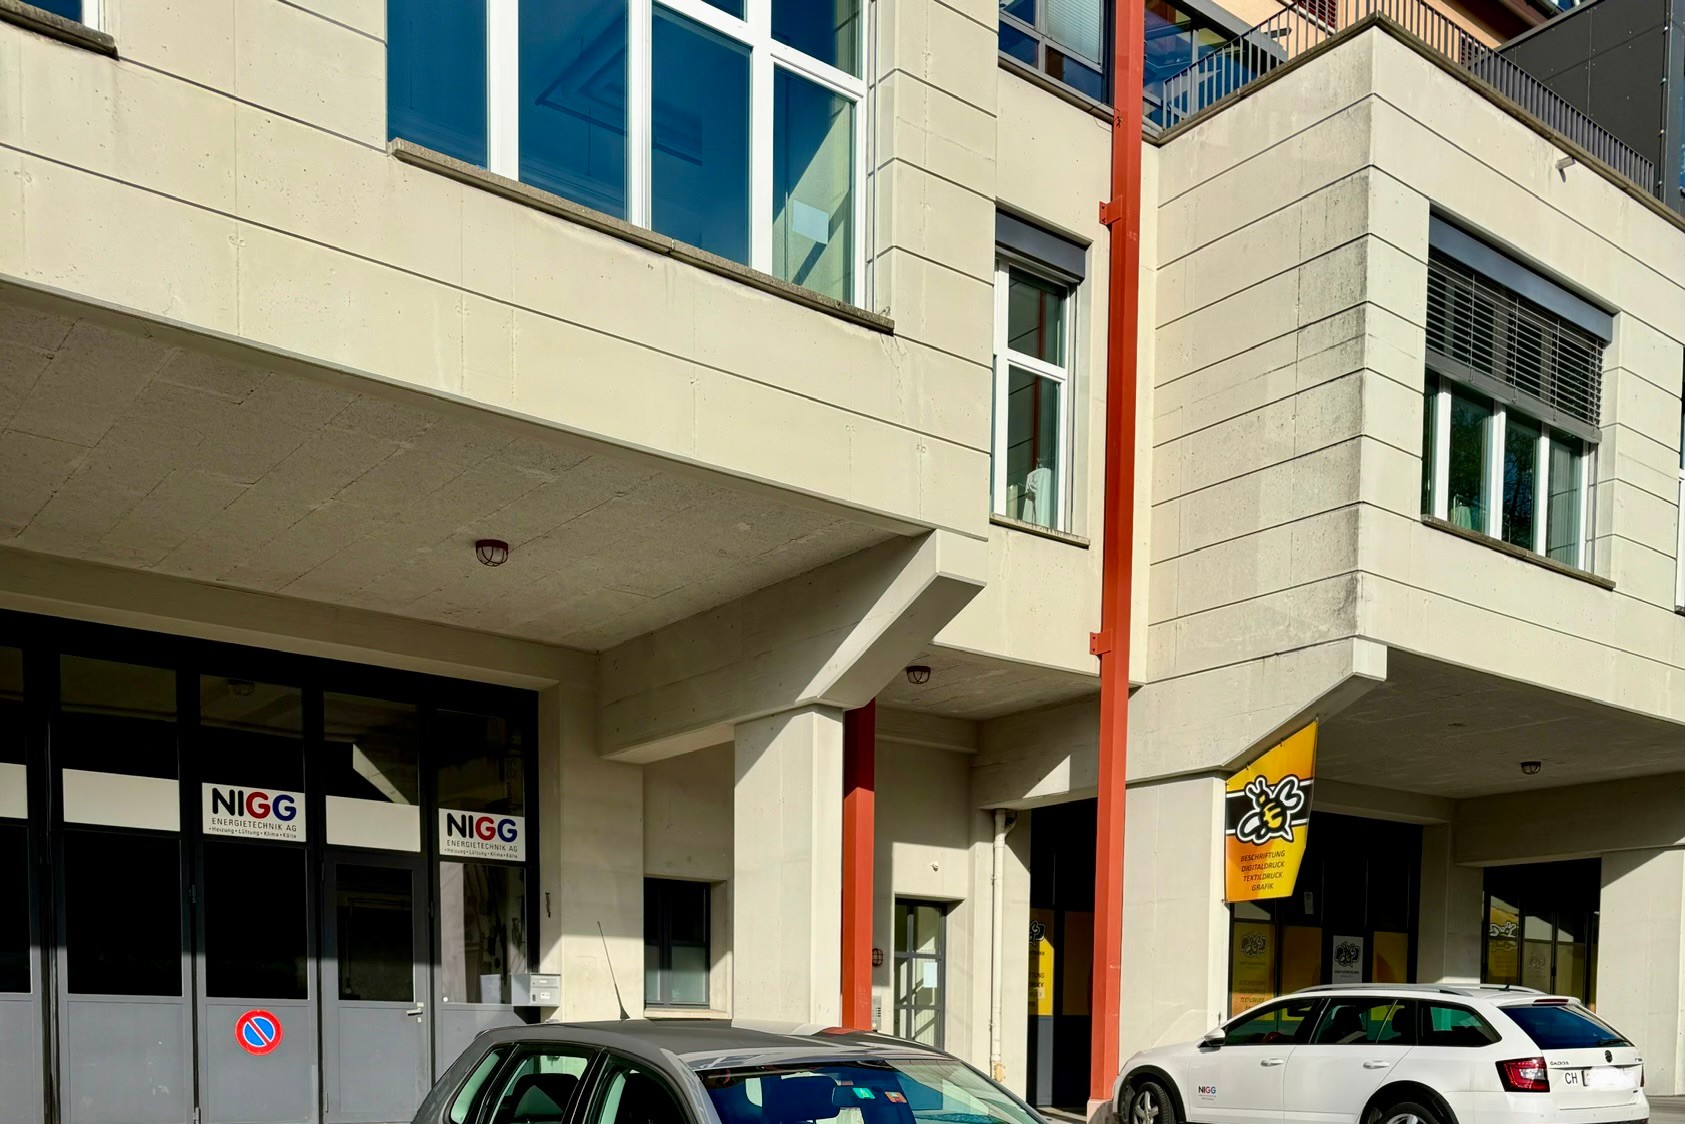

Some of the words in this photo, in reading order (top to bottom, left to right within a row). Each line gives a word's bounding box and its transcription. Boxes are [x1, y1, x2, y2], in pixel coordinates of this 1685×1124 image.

[212, 788, 296, 821] NIGG
[211, 818, 283, 831] ENERGIETECHNIK
[447, 813, 517, 842] NIGG
[446, 839, 507, 851] ENERGIETECHNIK
[1240, 850, 1286, 862] BESCHRIFTUNG
[1241, 861, 1285, 872] DIGITALDRUCK
[1243, 871, 1283, 882] TEXTILDRUCK
[1251, 883, 1274, 891] GRAFIK
[1564, 1072, 1578, 1084] CH
[1198, 1086, 1216, 1094] NIGG
